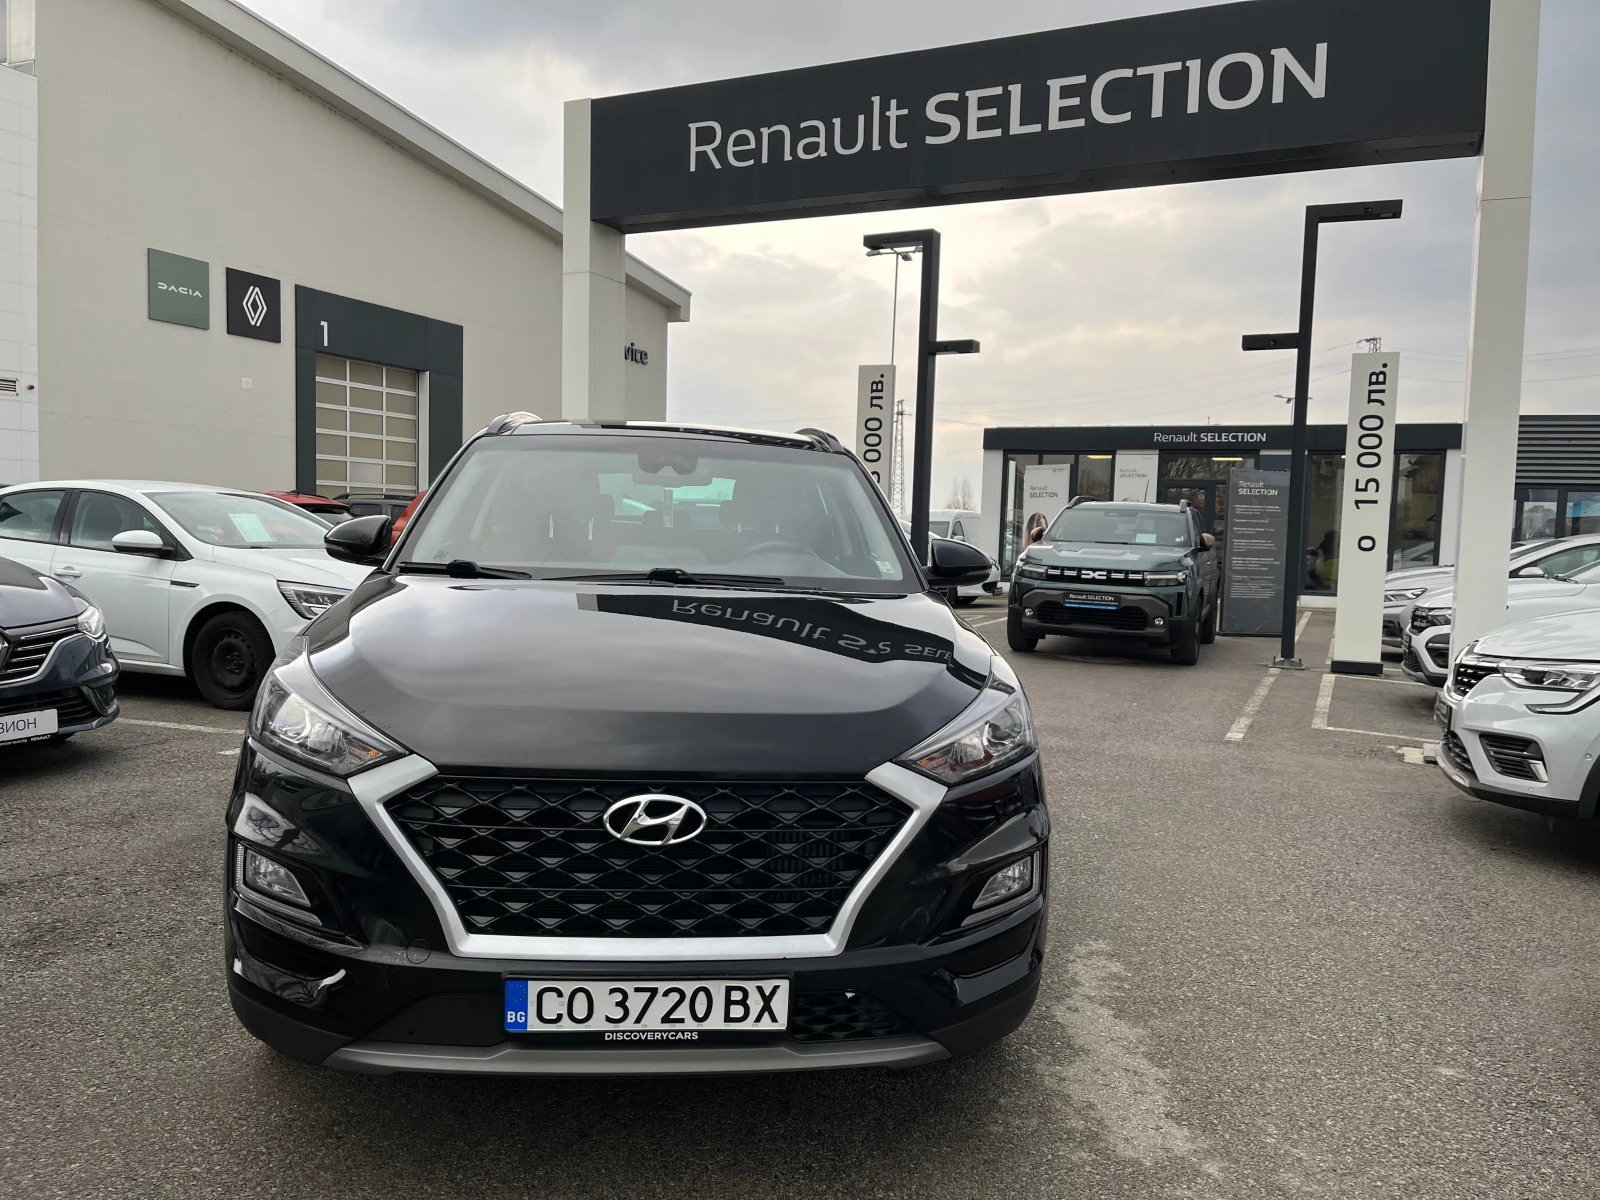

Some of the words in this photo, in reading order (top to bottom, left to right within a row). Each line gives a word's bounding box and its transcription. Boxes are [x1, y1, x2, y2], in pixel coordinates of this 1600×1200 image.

[687, 95, 908, 172] Renault
[924, 42, 1329, 145] SELECTION
[157, 281, 203, 298] DACIA
[320, 320, 329, 347] 1
[869, 373, 885, 410] лв.
[1367, 362, 1388, 407] лв.
[1153, 431, 1198, 442] Renault
[1200, 432, 1267, 442] SELECTION
[1356, 414, 1385, 469] 000
[1238, 488, 1279, 496] SELECTION
[1239, 480, 1264, 488] Renault
[1354, 477, 1380, 510] 15
[506, 1010, 526, 1023] BG
[536, 986, 595, 1025] CO
[604, 985, 714, 1024] 3720
[723, 984, 781, 1024] BX
[604, 1031, 699, 1041] DISCOVERYCARS
